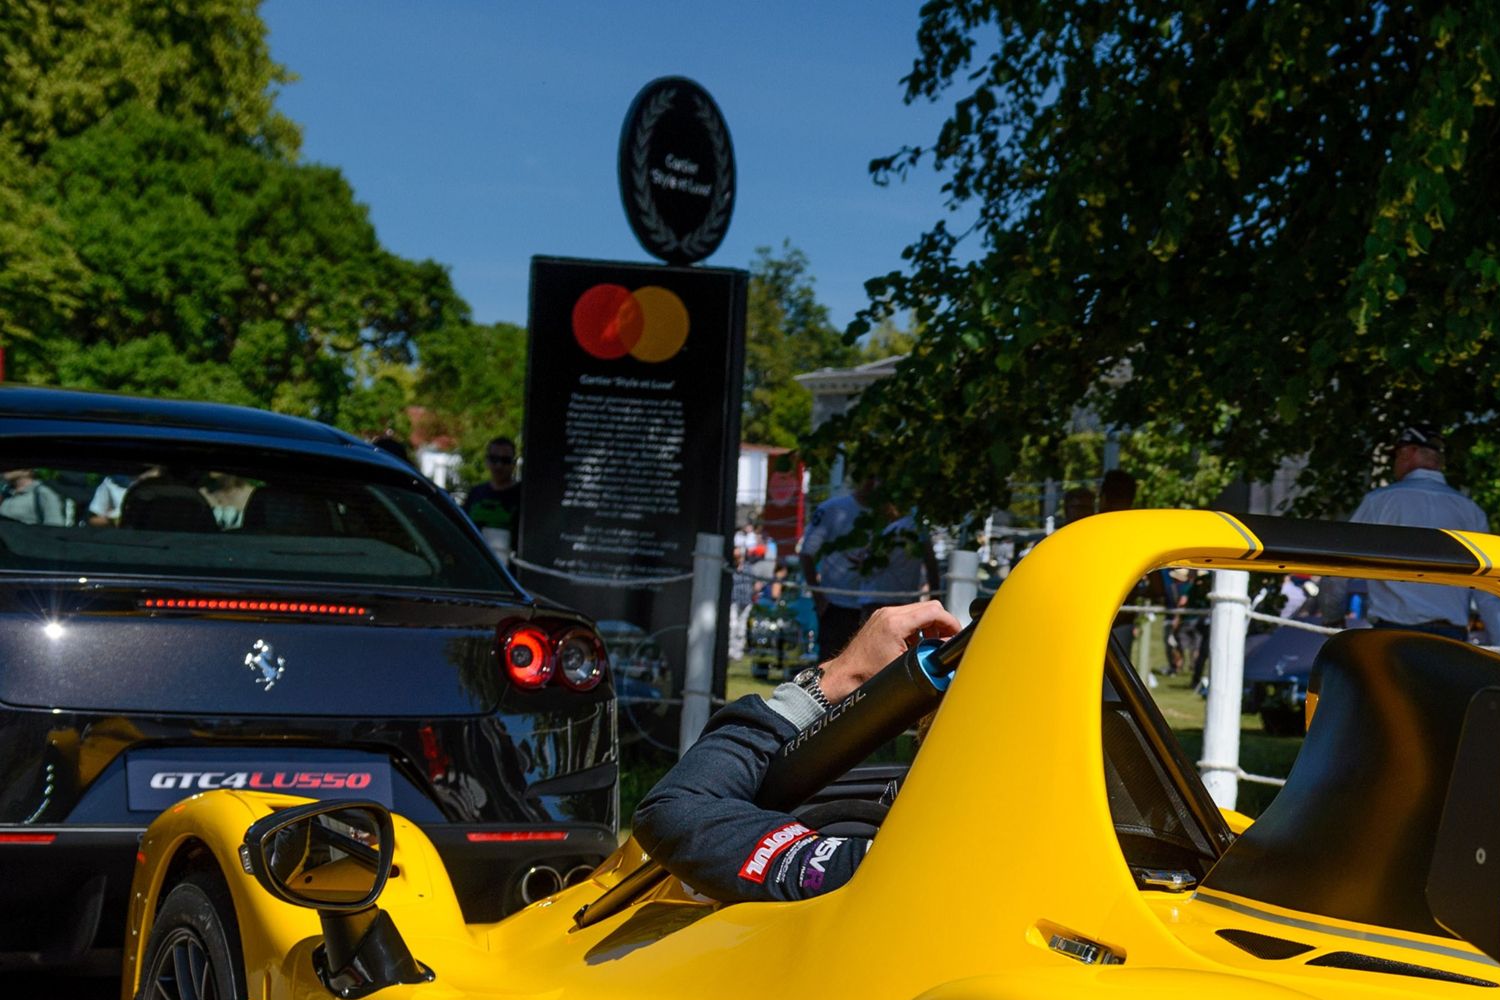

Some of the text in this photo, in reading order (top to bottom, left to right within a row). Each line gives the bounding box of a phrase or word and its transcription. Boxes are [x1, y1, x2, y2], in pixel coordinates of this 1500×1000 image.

[784, 689, 867, 757] RADICAL
[150, 771, 372, 789] GTC4LUSSO
[745, 823, 810, 876] MOTUL
